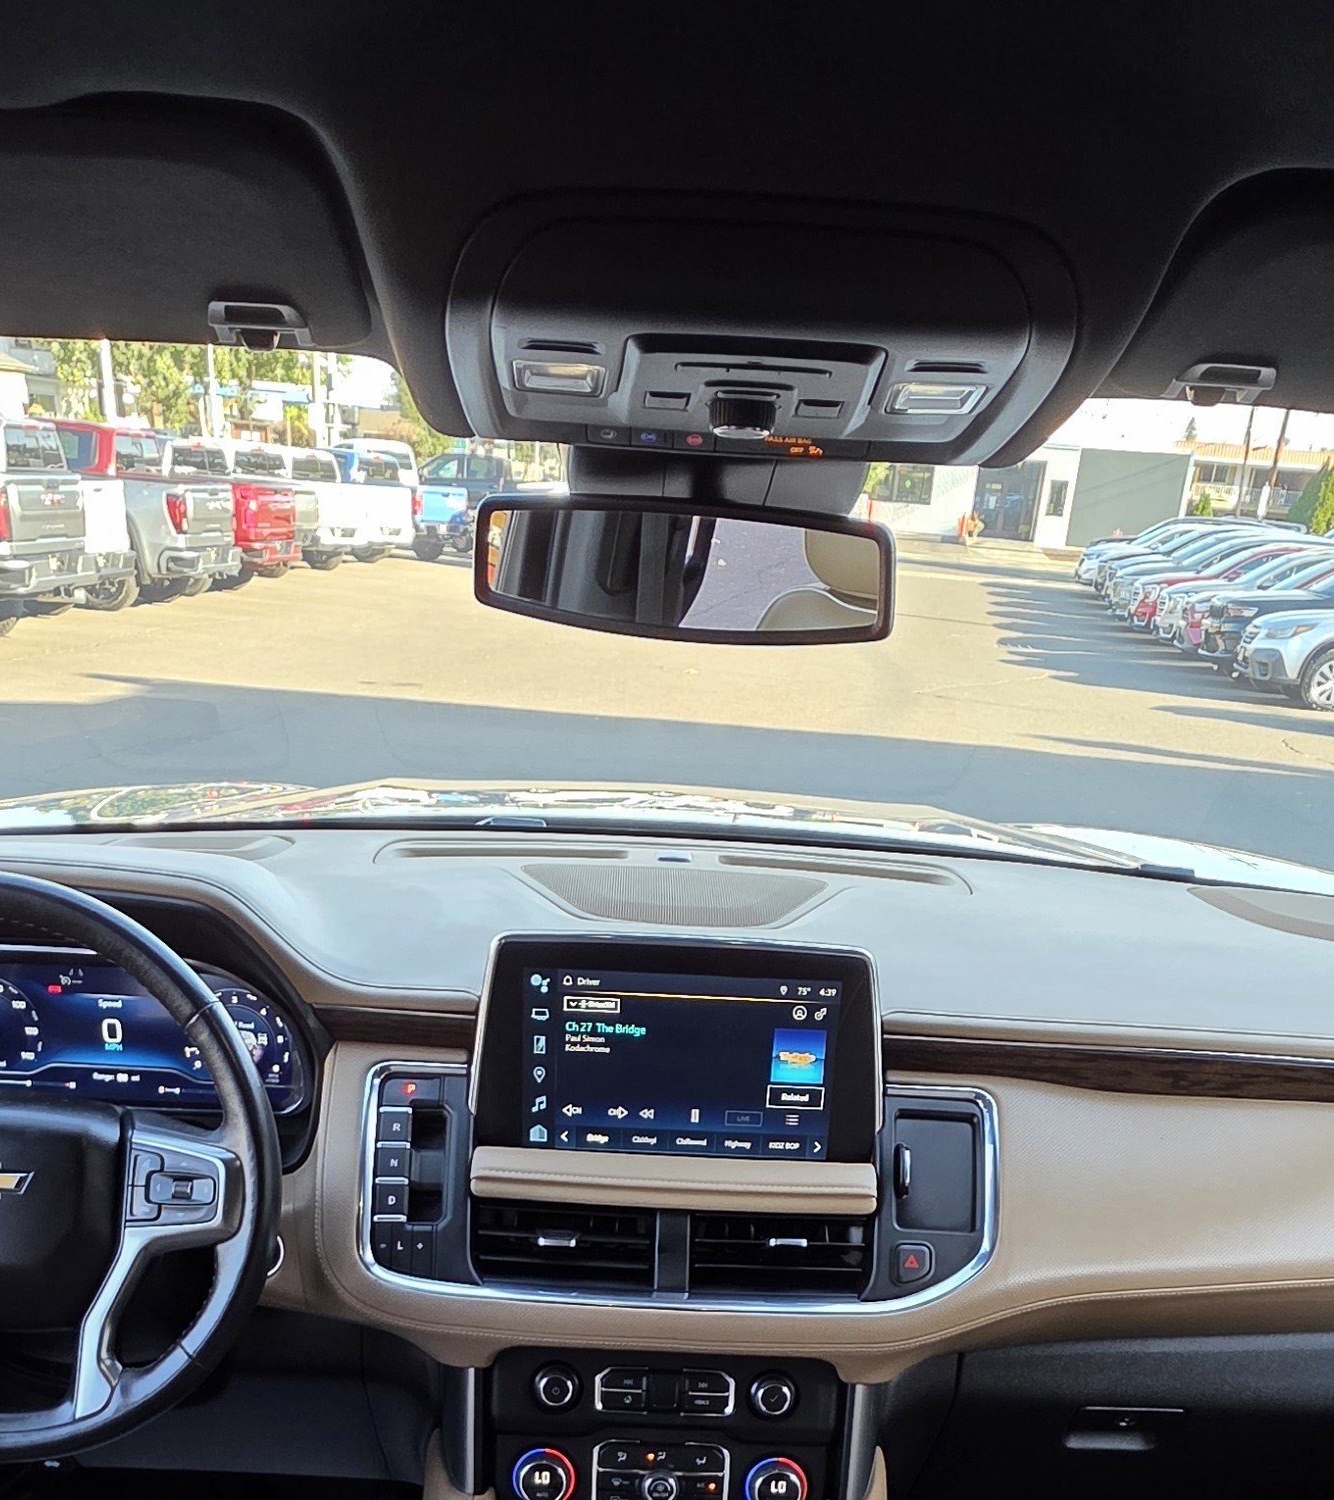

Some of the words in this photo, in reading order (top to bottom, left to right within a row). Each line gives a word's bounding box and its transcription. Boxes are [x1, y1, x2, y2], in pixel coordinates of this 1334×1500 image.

[577, 977, 601, 987] Driver
[101, 1018, 123, 1043] 0
[565, 1021, 580, 1032] Ch
[580, 1022, 593, 1032] 27
[596, 1023, 615, 1034] The
[615, 1024, 647, 1037] Bridge
[565, 1034, 581, 1043] Paul
[582, 1034, 606, 1043] Simon
[564, 1044, 611, 1054] Kodachrome
[392, 1122, 401, 1132] R
[389, 1158, 399, 1167] N
[387, 1195, 397, 1206] D
